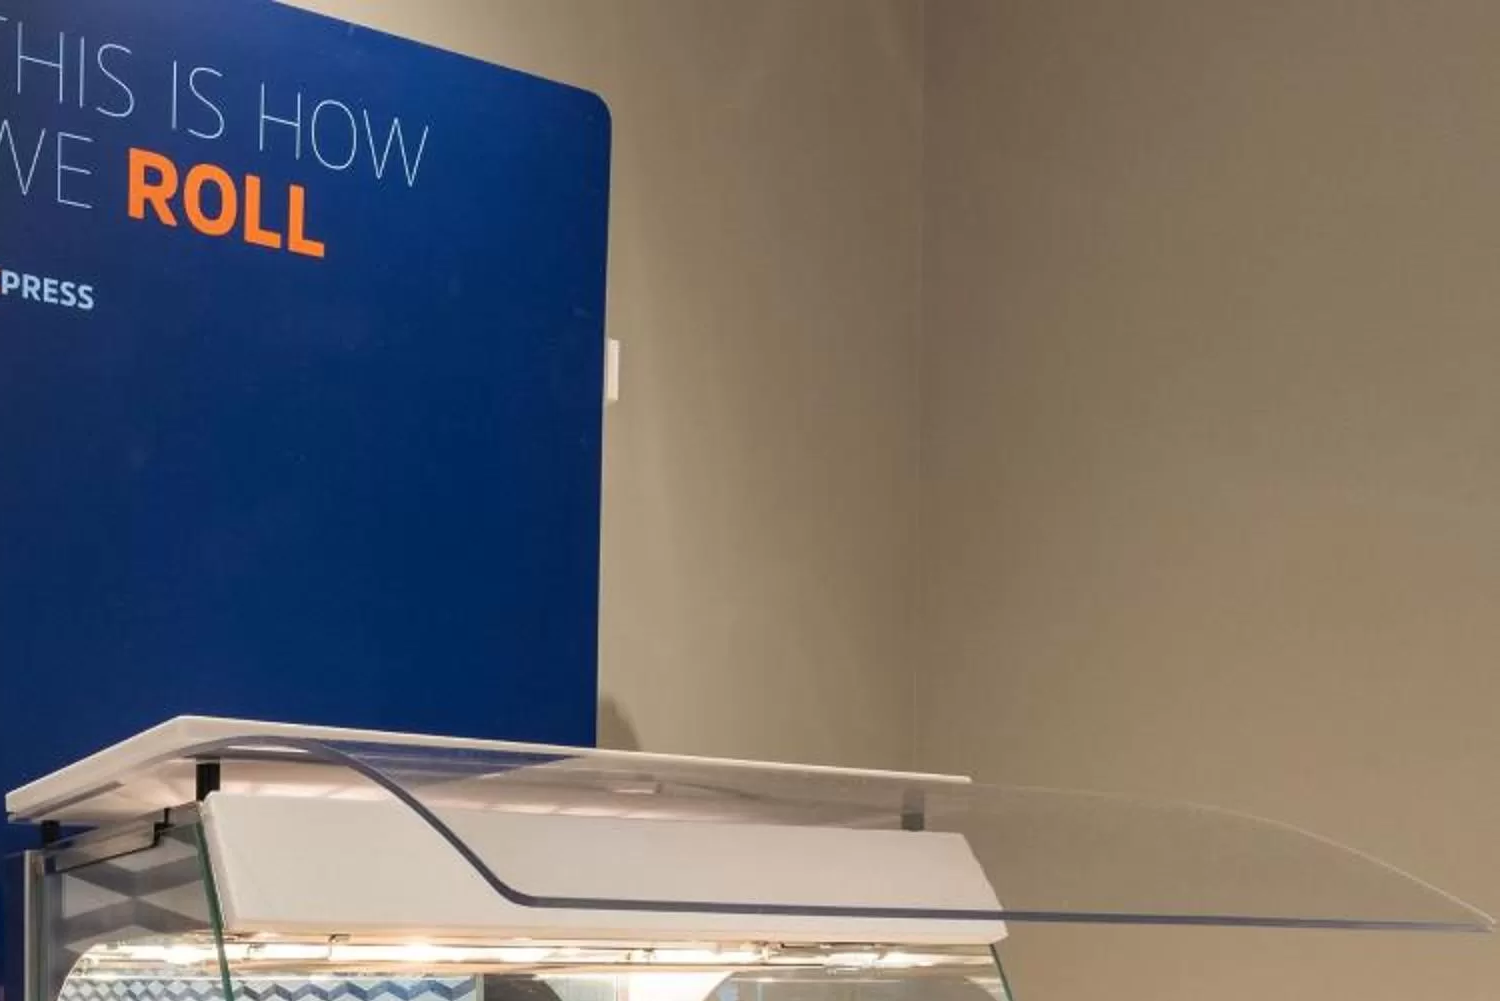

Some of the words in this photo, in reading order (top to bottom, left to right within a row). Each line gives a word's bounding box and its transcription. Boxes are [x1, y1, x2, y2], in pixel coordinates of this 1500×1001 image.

[171, 60, 226, 140] IS
[258, 83, 430, 188] HOW
[127, 146, 326, 259] ROLL
